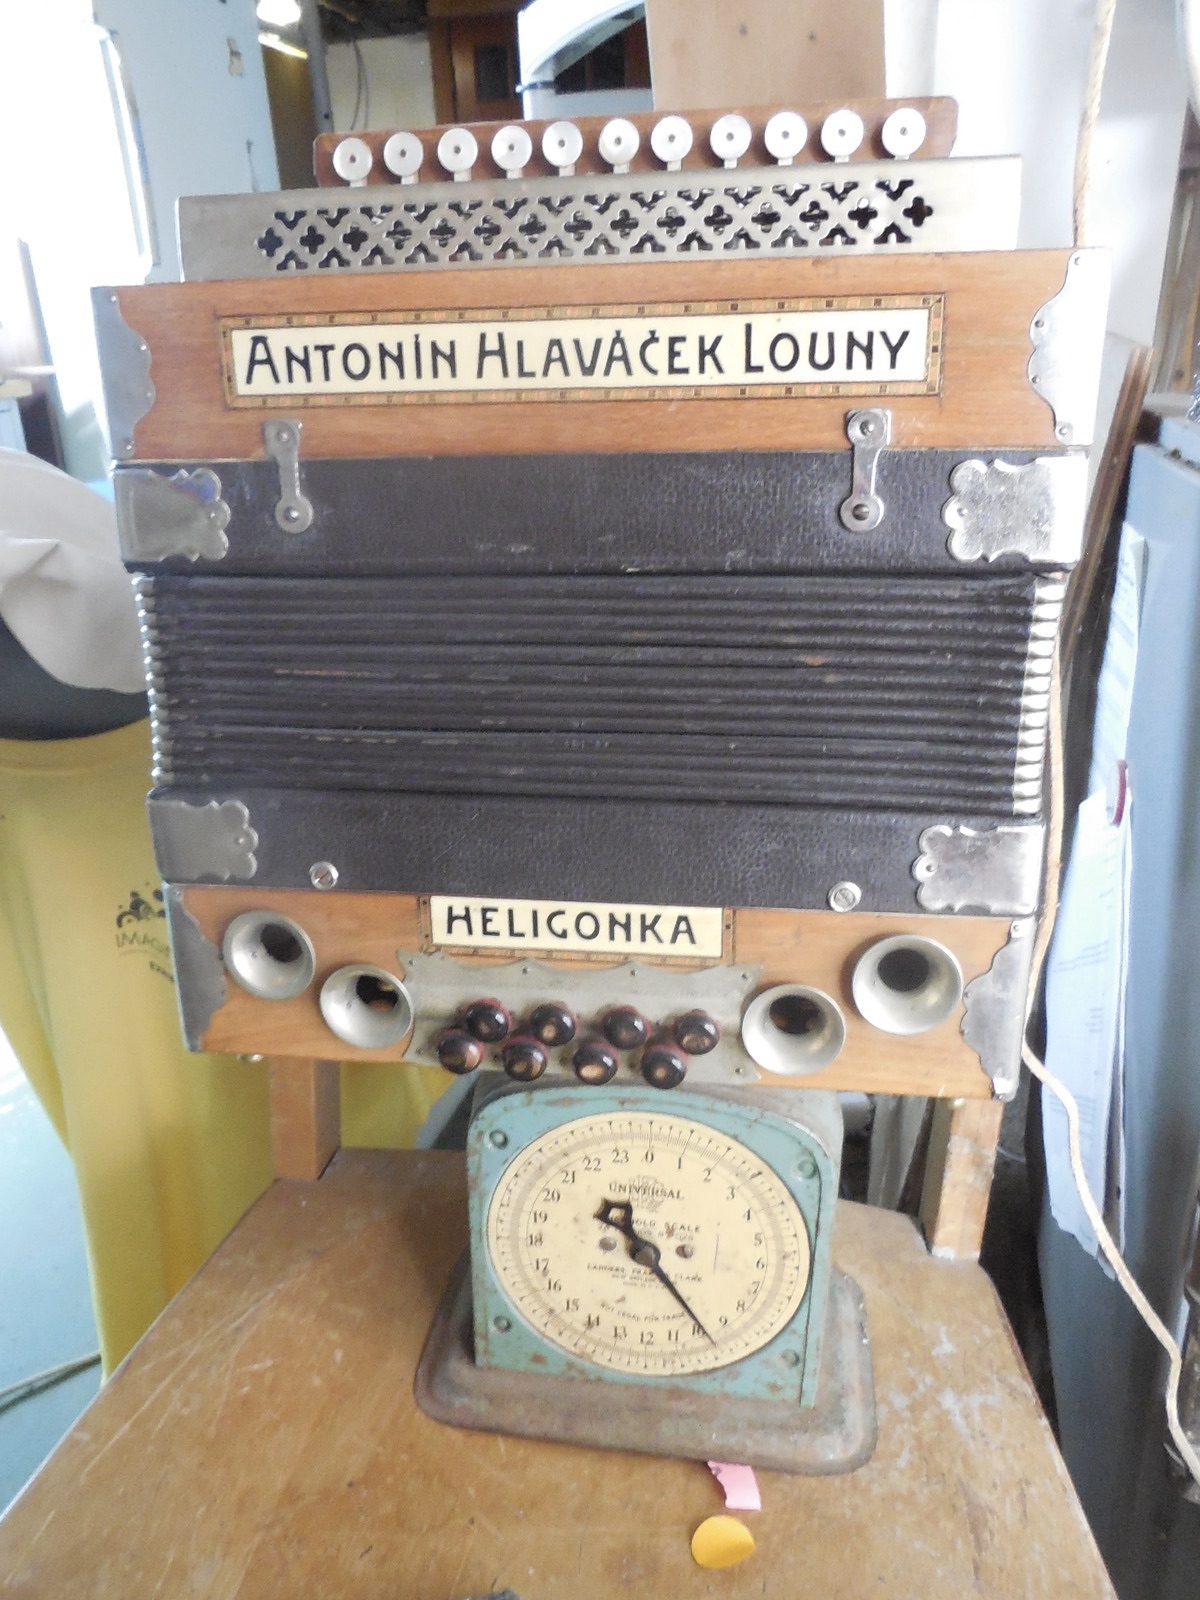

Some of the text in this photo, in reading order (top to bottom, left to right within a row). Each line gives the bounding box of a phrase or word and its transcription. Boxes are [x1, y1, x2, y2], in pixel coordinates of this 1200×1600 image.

[744, 322, 911, 374] LOUNY
[446, 905, 697, 945] HELIGONKA
[611, 1147, 630, 1163] 23
[645, 1150, 654, 1163] 0
[583, 1155, 602, 1171] 22
[561, 1170, 576, 1184] 21
[703, 1168, 711, 1182] 2
[543, 1187, 561, 1203] 20
[609, 1183, 684, 1200] UNIVERSAL
[726, 1186, 735, 1200] 3
[533, 1210, 548, 1223] 19
[742, 1208, 751, 1221] 4
[529, 1232, 543, 1247] 18
[754, 1232, 762, 1246] 5
[535, 1258, 549, 1272] 17
[756, 1257, 765, 1270] 6
[548, 1278, 562, 1292] 16
[752, 1281, 760, 1295] 7
[566, 1298, 580, 1312] 15
[736, 1300, 745, 1313] 8
[587, 1313, 600, 1327] 14
[719, 1315, 728, 1327] 9
[613, 1325, 627, 1339] 13
[640, 1330, 654, 1346] 12
[668, 1329, 679, 1342] 11
